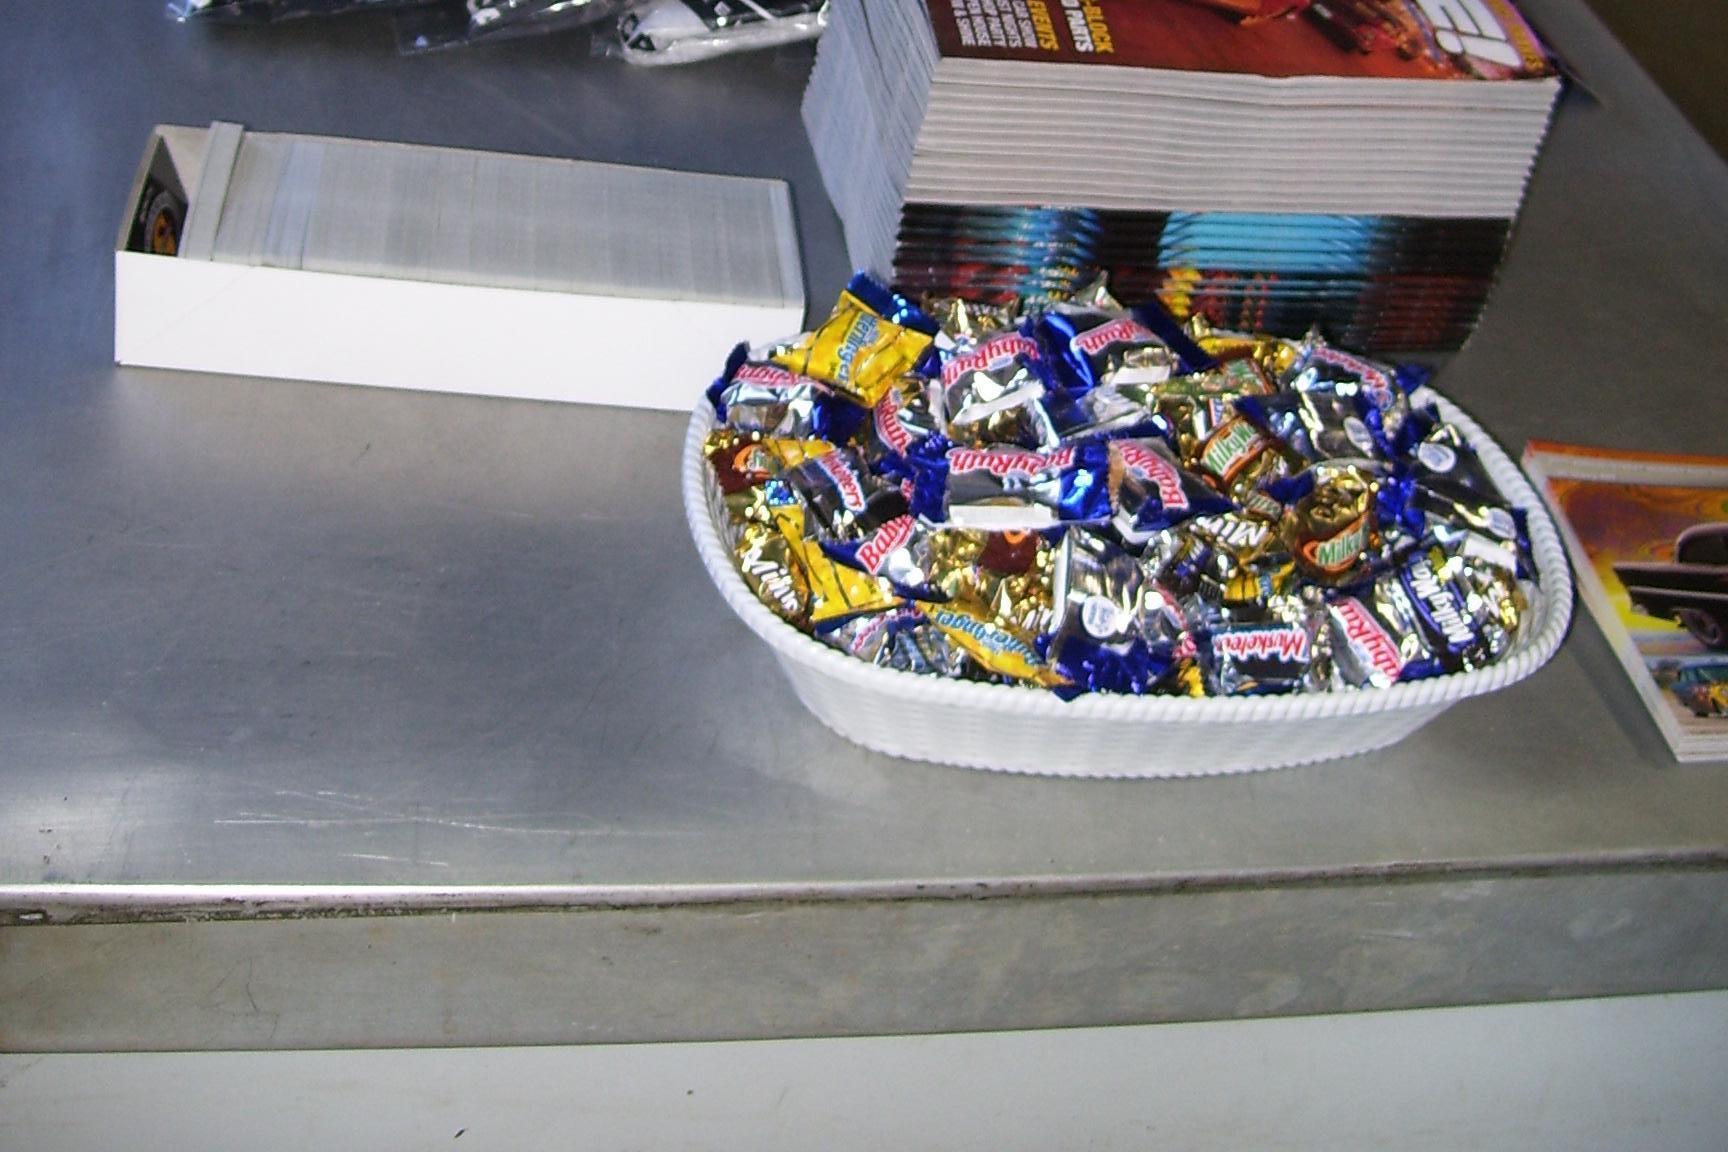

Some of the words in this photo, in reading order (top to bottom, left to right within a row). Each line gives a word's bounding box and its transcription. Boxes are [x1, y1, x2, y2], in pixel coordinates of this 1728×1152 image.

[1064, 8, 1095, 53] PARTS
[833, 311, 878, 384] terfinger
[1073, 318, 1152, 356] yRuth
[856, 514, 915, 574] Baby
[1336, 599, 1401, 681] abyRu
